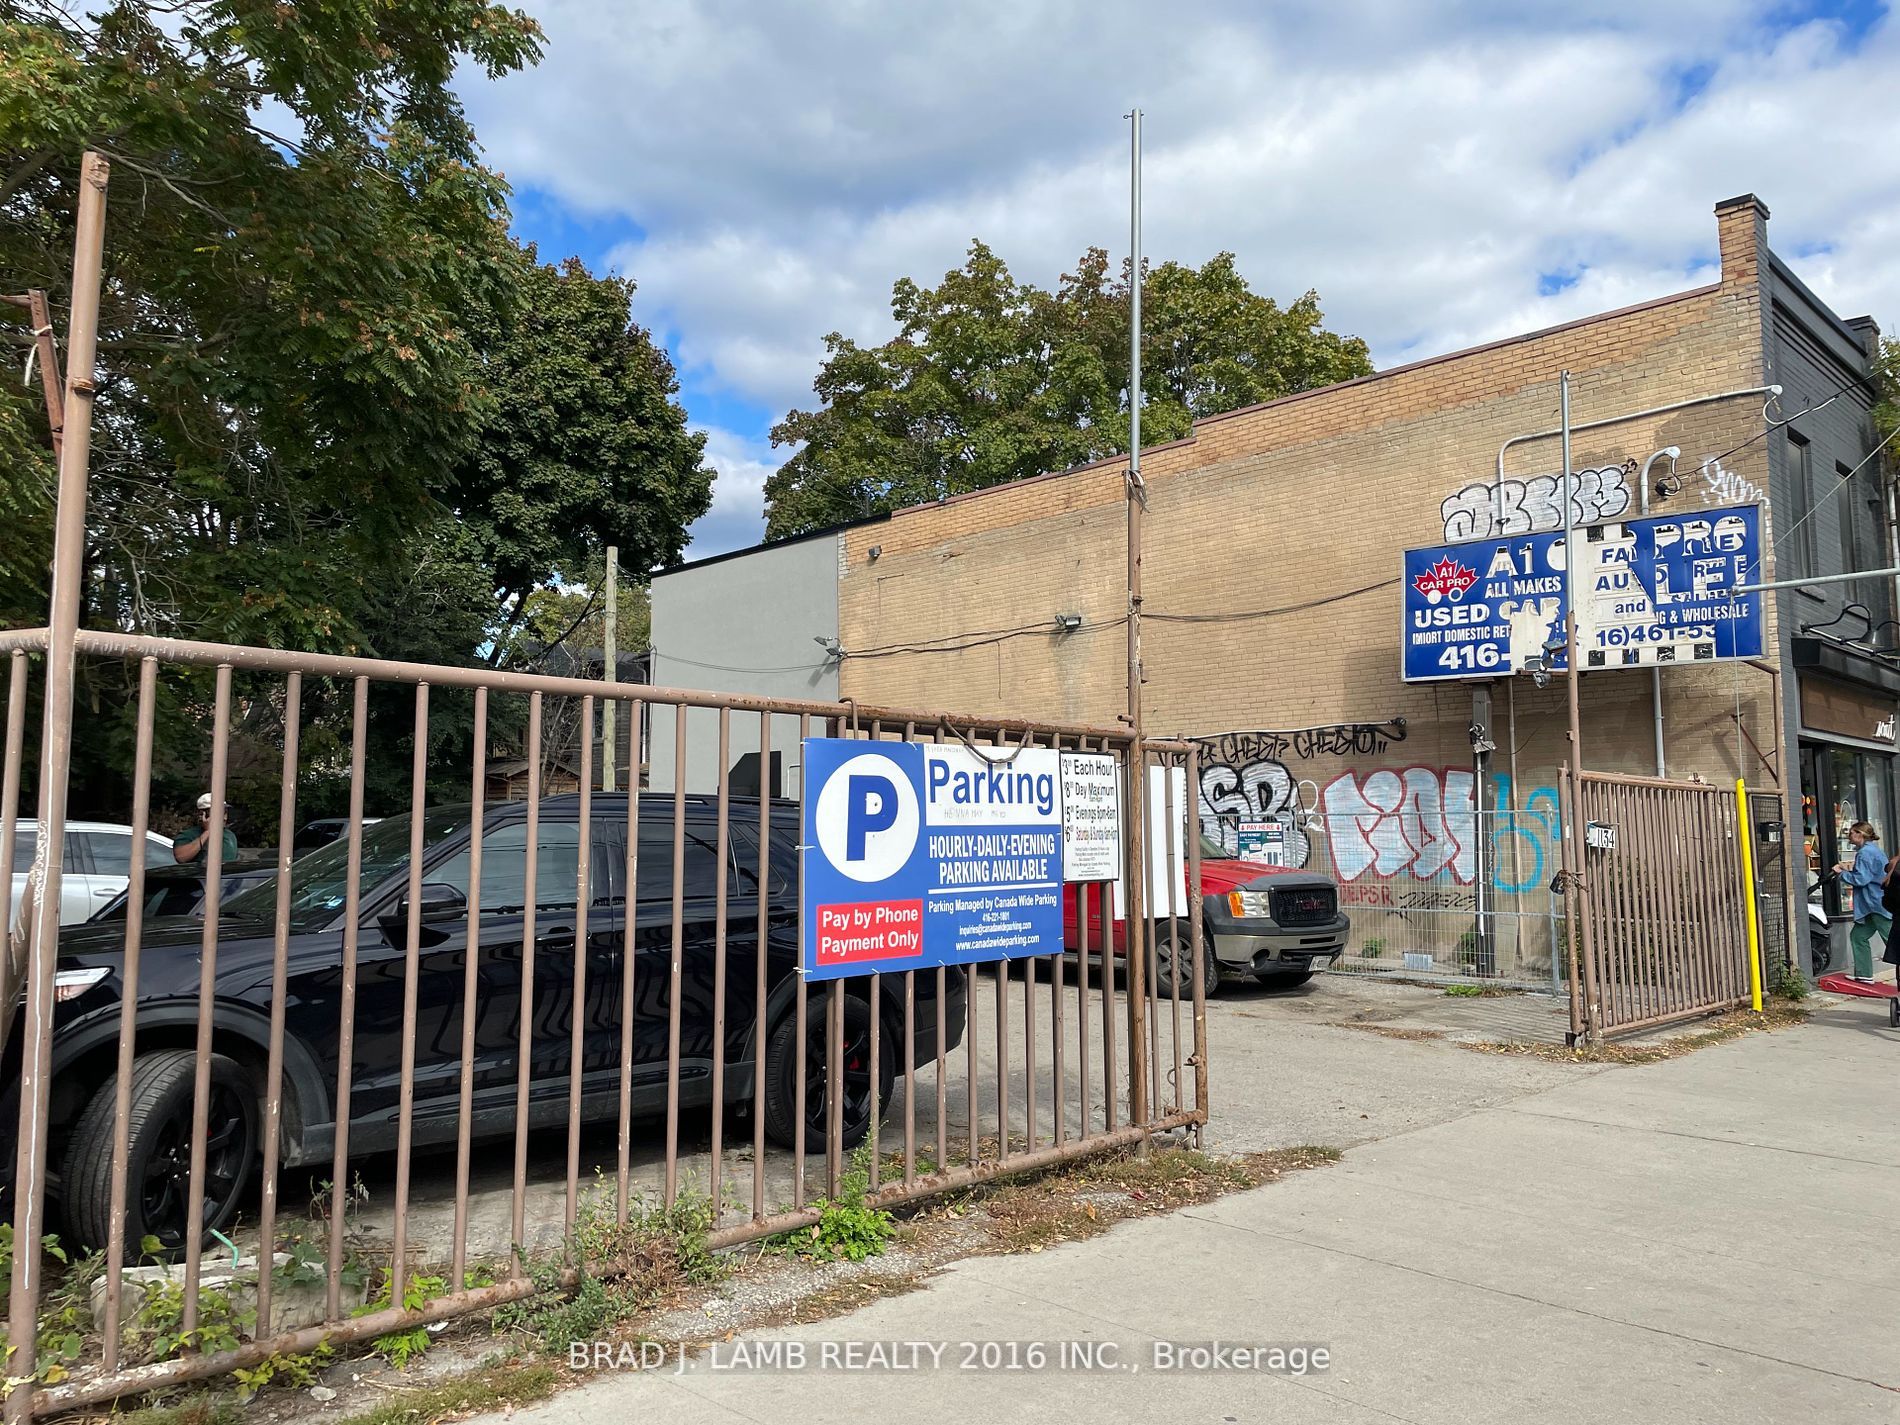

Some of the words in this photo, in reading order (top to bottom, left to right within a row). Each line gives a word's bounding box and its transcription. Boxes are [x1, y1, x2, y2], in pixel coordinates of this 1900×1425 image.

[1486, 542, 1534, 579] A1
[1440, 566, 1453, 579] A1
[1420, 580, 1444, 592] CAR
[1446, 576, 1470, 588] PRO
[1484, 582, 1510, 599] ALL
[1514, 576, 1562, 596] MAKES
[1414, 603, 1490, 628] USED
[1615, 600, 1646, 614] and
[1669, 610, 1678, 623] &
[1682, 603, 1750, 623] WHOLESALE
[1444, 626, 1490, 642] DOMESTIC
[1074, 760, 1094, 776] Each
[1096, 760, 1113, 776] Hour
[929, 758, 1054, 816] Parking
[1076, 782, 1088, 800] Day
[1088, 782, 1114, 797] Maximum
[846, 774, 899, 862] P
[1076, 806, 1097, 824] Evenings
[930, 834, 1055, 858] HOURLY-DAILY-EVENING
[1598, 829, 1615, 848] 1134
[940, 860, 989, 884] PARKING
[992, 858, 1048, 882] AVAILABLE
[928, 901, 954, 914] Parking
[955, 898, 984, 913] Managed
[985, 897, 994, 912] by
[994, 896, 1018, 908] Canada
[1018, 894, 1034, 906] Wide
[1034, 894, 1058, 908] Parking
[822, 910, 850, 930] Pay
[854, 909, 872, 929] by
[876, 907, 918, 924] Phone
[822, 932, 884, 957] Payment
[888, 930, 919, 950] Only
[955, 934, 1040, 951] www.canadawideparking.com
